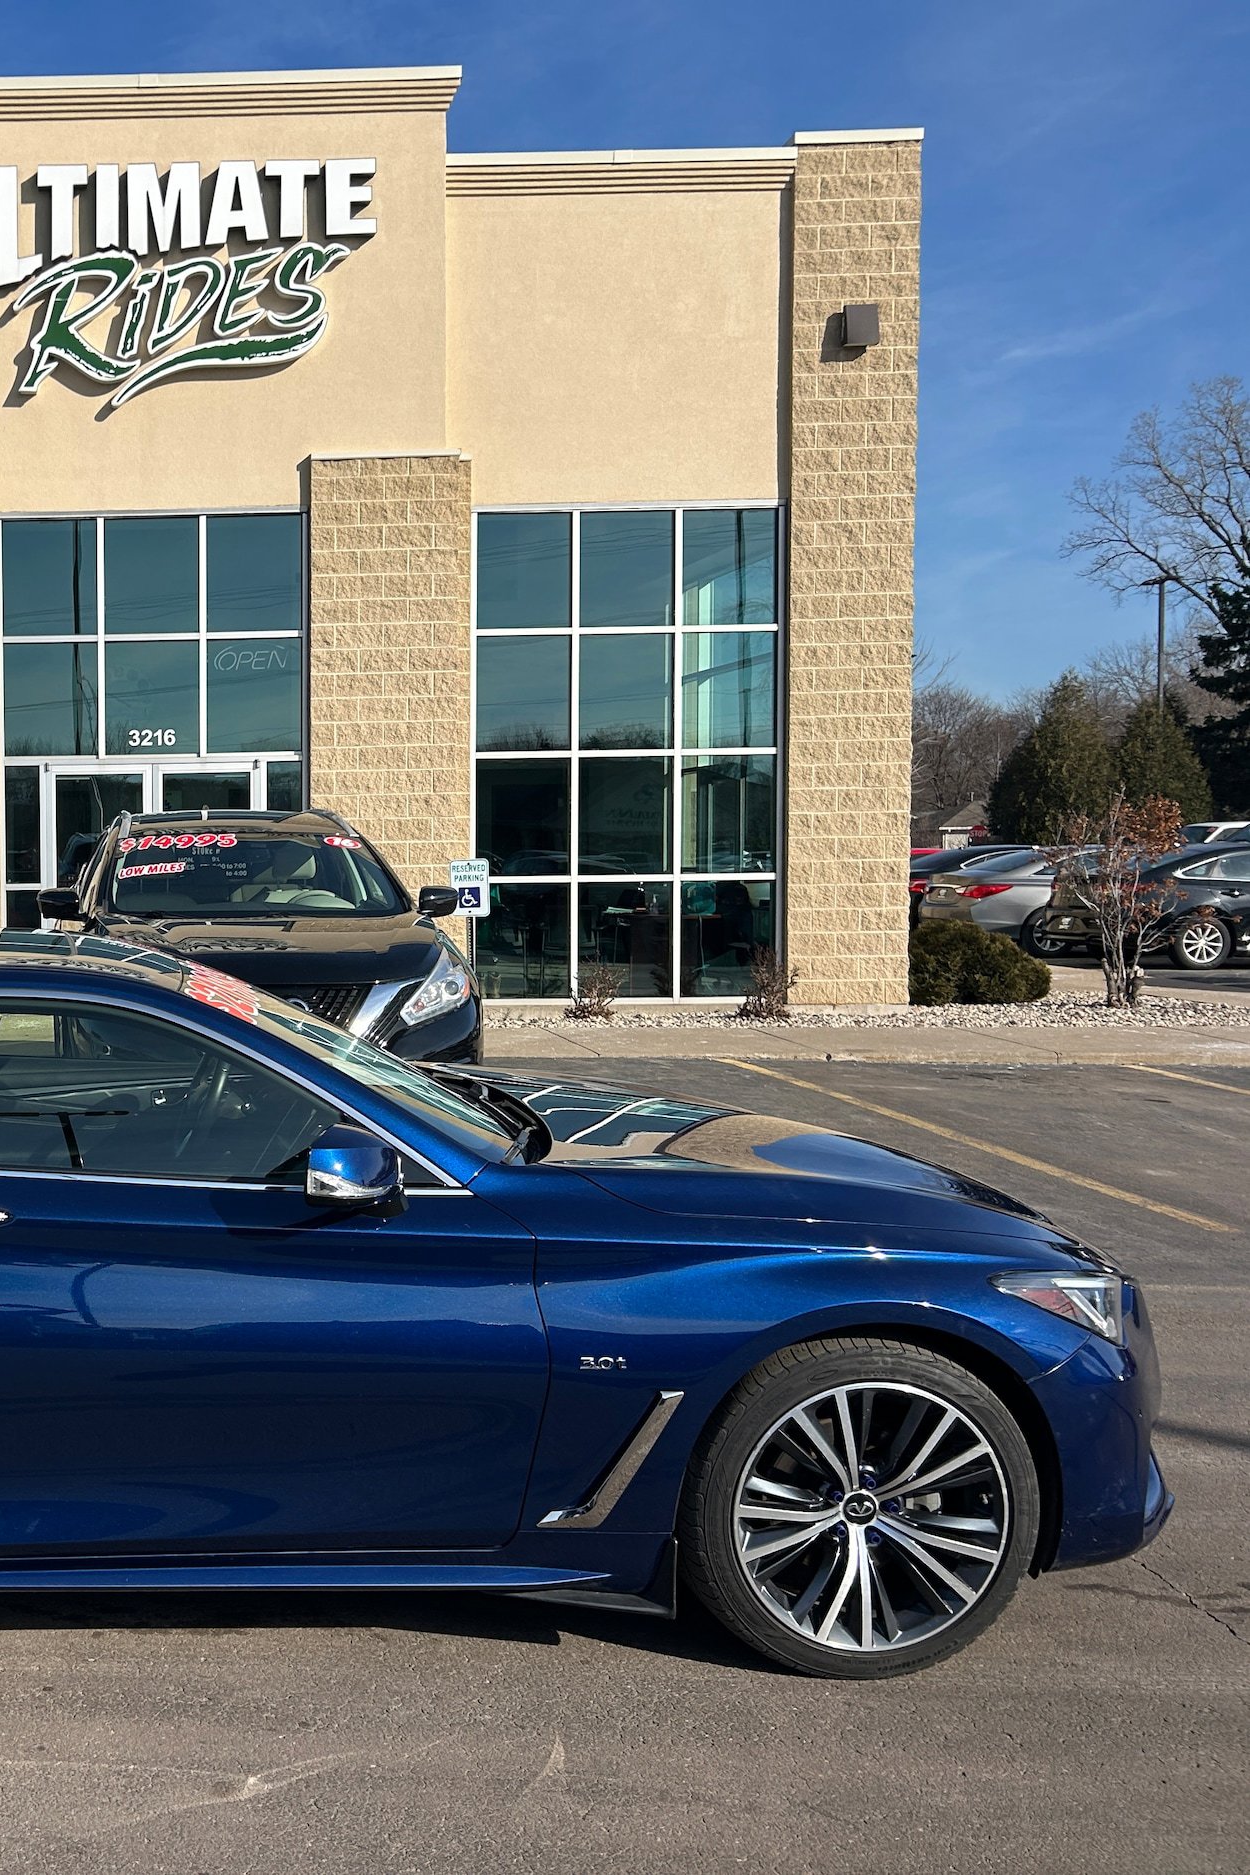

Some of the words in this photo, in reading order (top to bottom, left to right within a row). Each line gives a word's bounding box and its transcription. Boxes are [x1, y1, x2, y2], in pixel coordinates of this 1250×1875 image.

[217, 650, 288, 671] OPEN
[128, 729, 176, 746] 3216
[120, 834, 237, 852] $14995
[120, 866, 145, 878] LOW
[147, 863, 185, 875] MILES
[452, 864, 486, 872] RESERVED
[454, 874, 484, 882] PARKING
